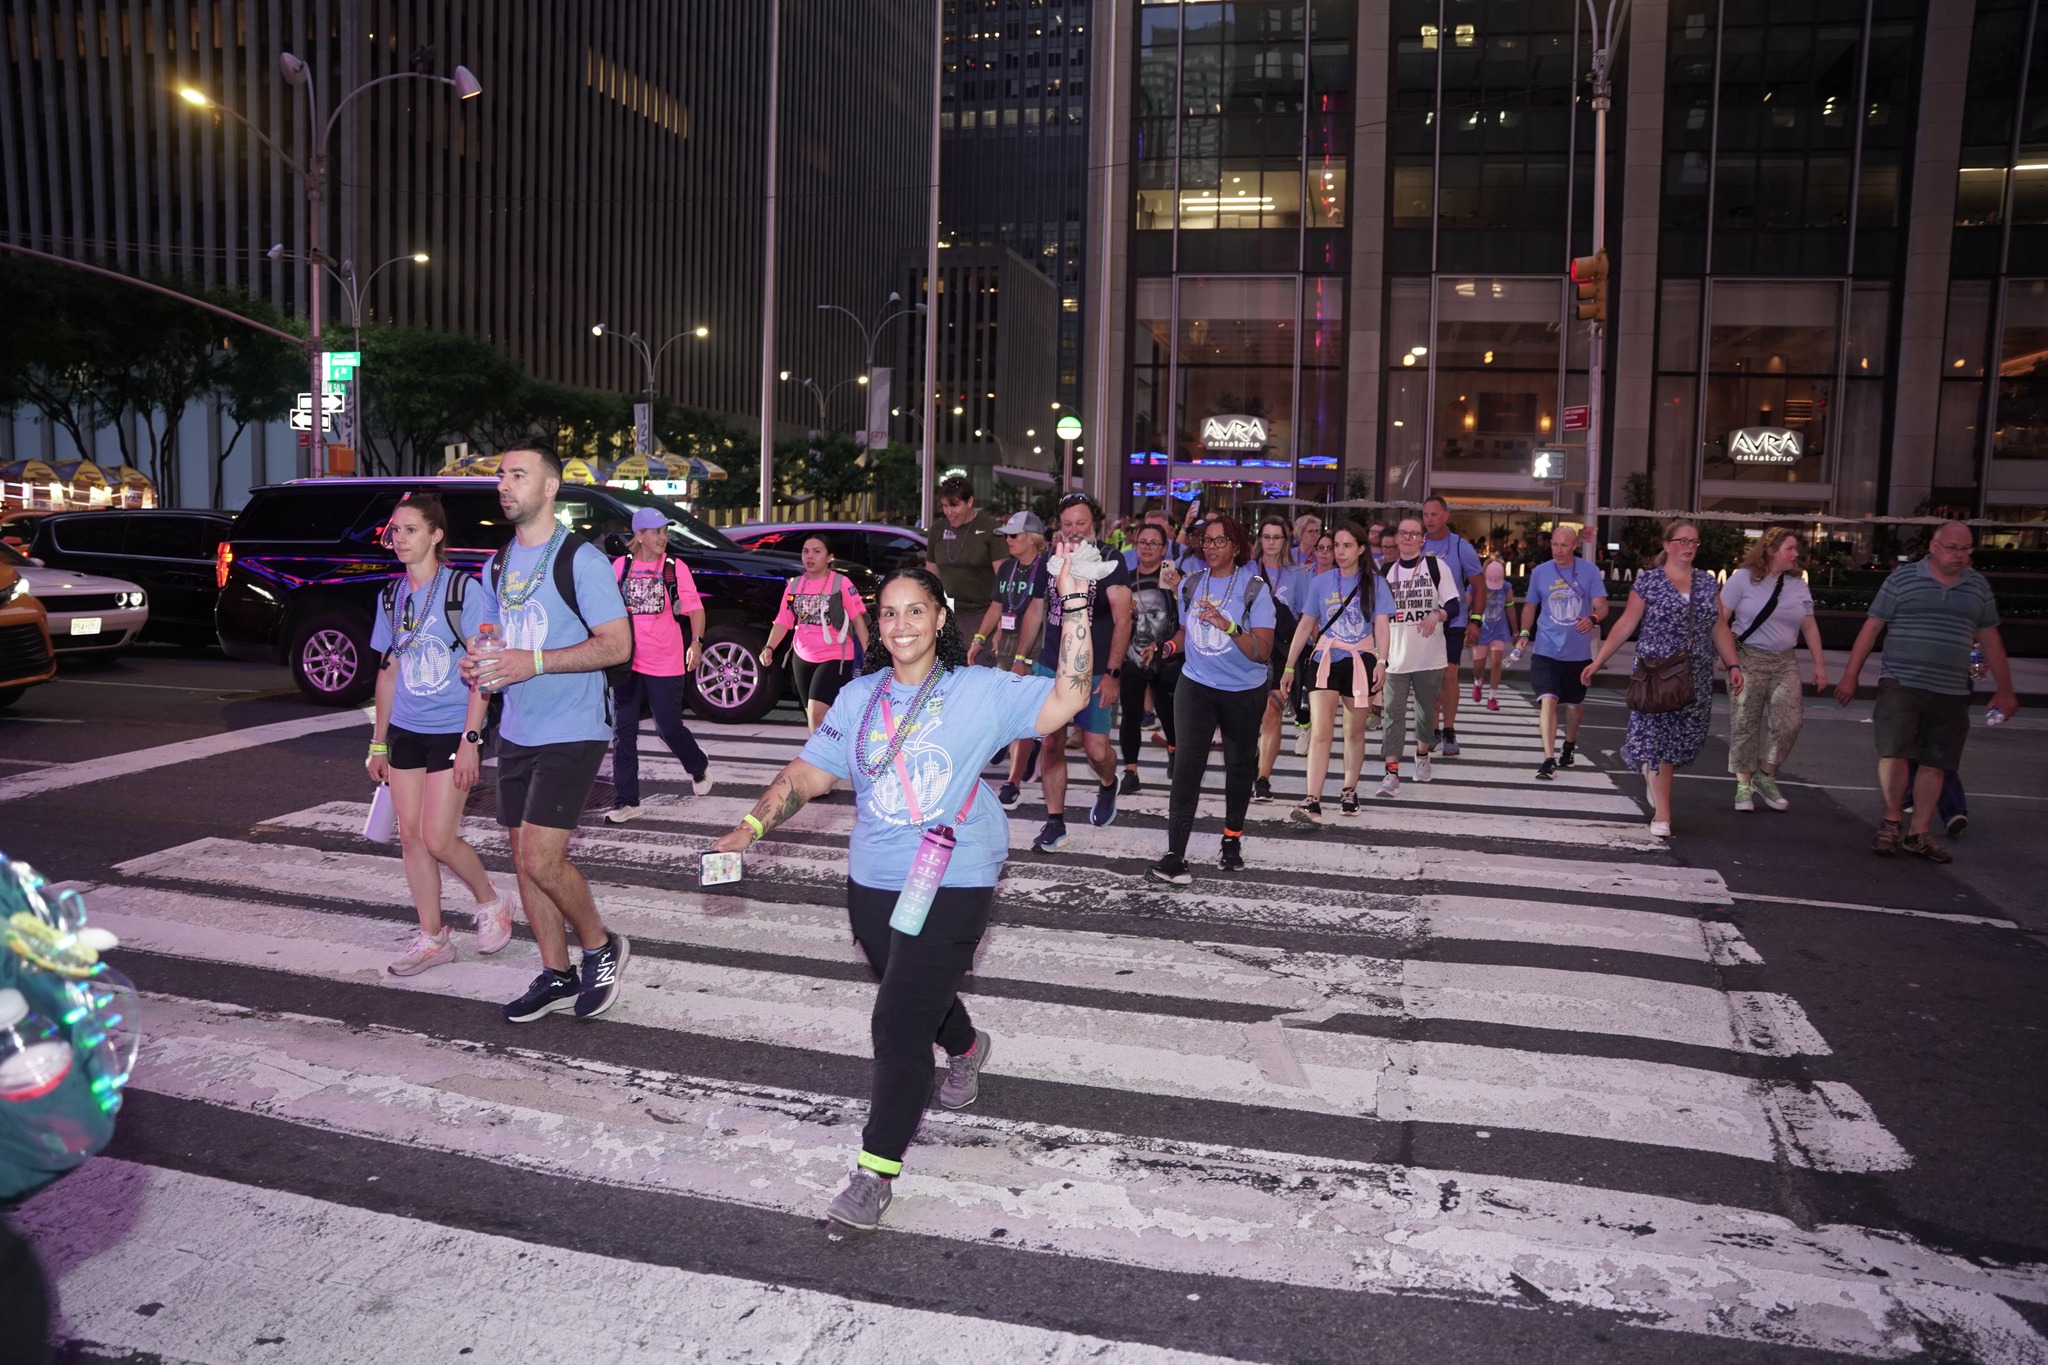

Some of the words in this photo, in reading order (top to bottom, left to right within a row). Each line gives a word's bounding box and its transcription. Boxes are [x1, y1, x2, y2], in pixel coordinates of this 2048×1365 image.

[1204, 418, 1266, 441] AVRA
[1731, 430, 1799, 456] AVRA
[1736, 454, 1793, 462] estiatorio
[821, 723, 843, 741] LIGHT
